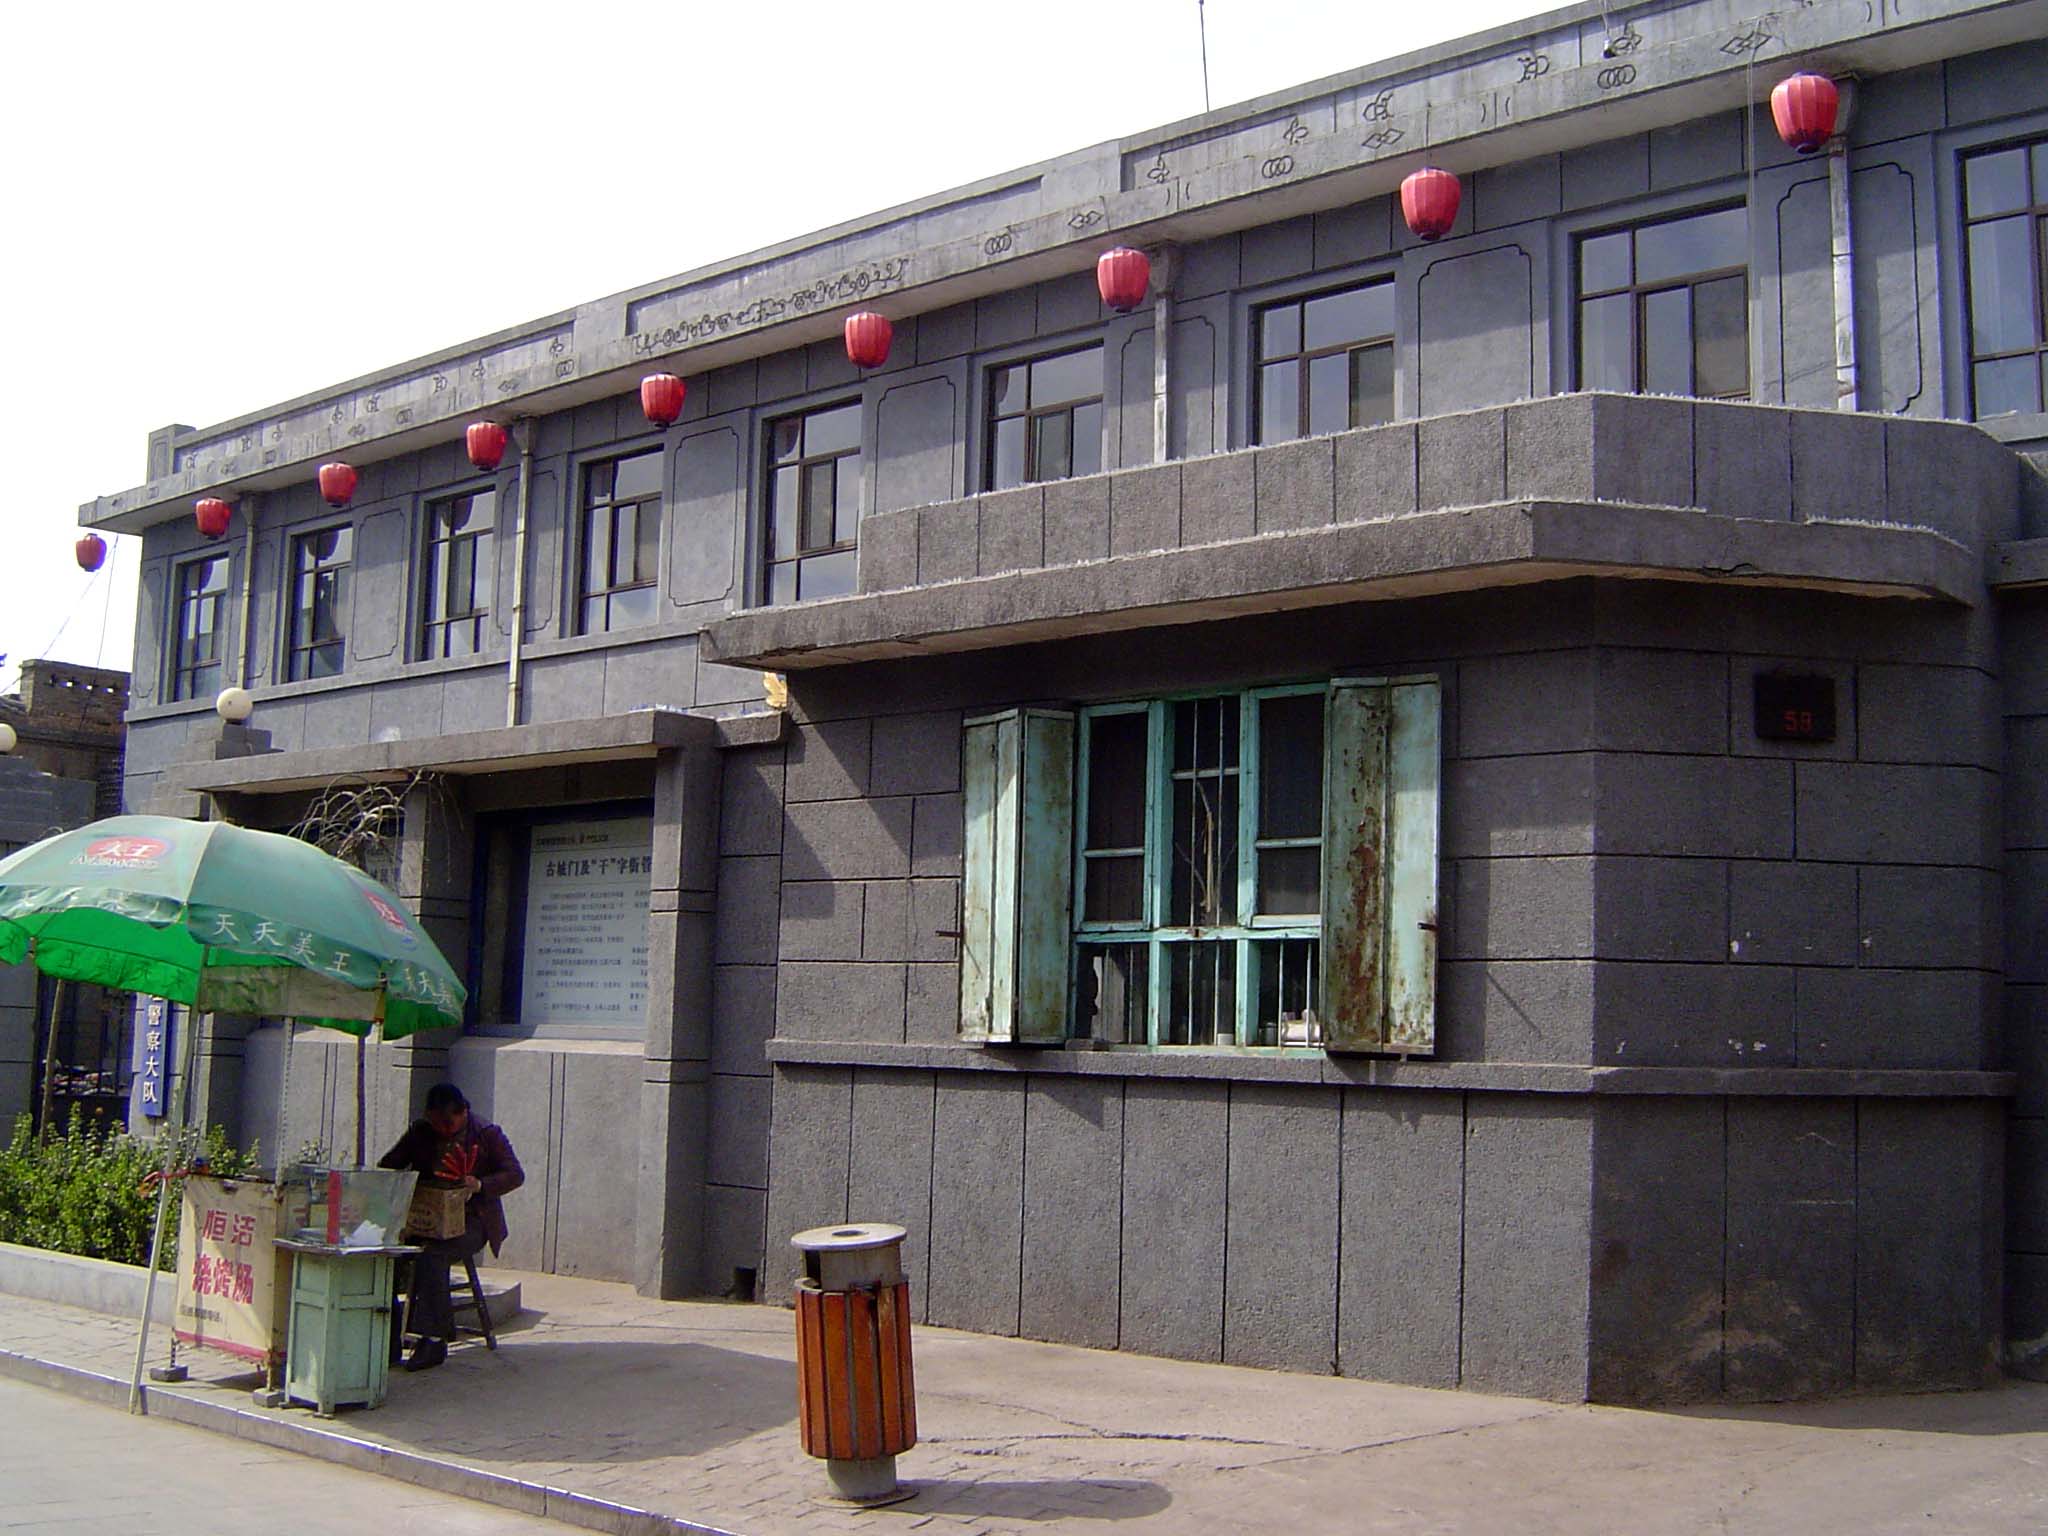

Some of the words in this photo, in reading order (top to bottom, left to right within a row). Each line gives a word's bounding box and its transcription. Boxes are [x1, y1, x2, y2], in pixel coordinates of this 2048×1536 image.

[213, 913, 353, 977] 天天美王
[192, 1253, 254, 1305] 烧烤肠
